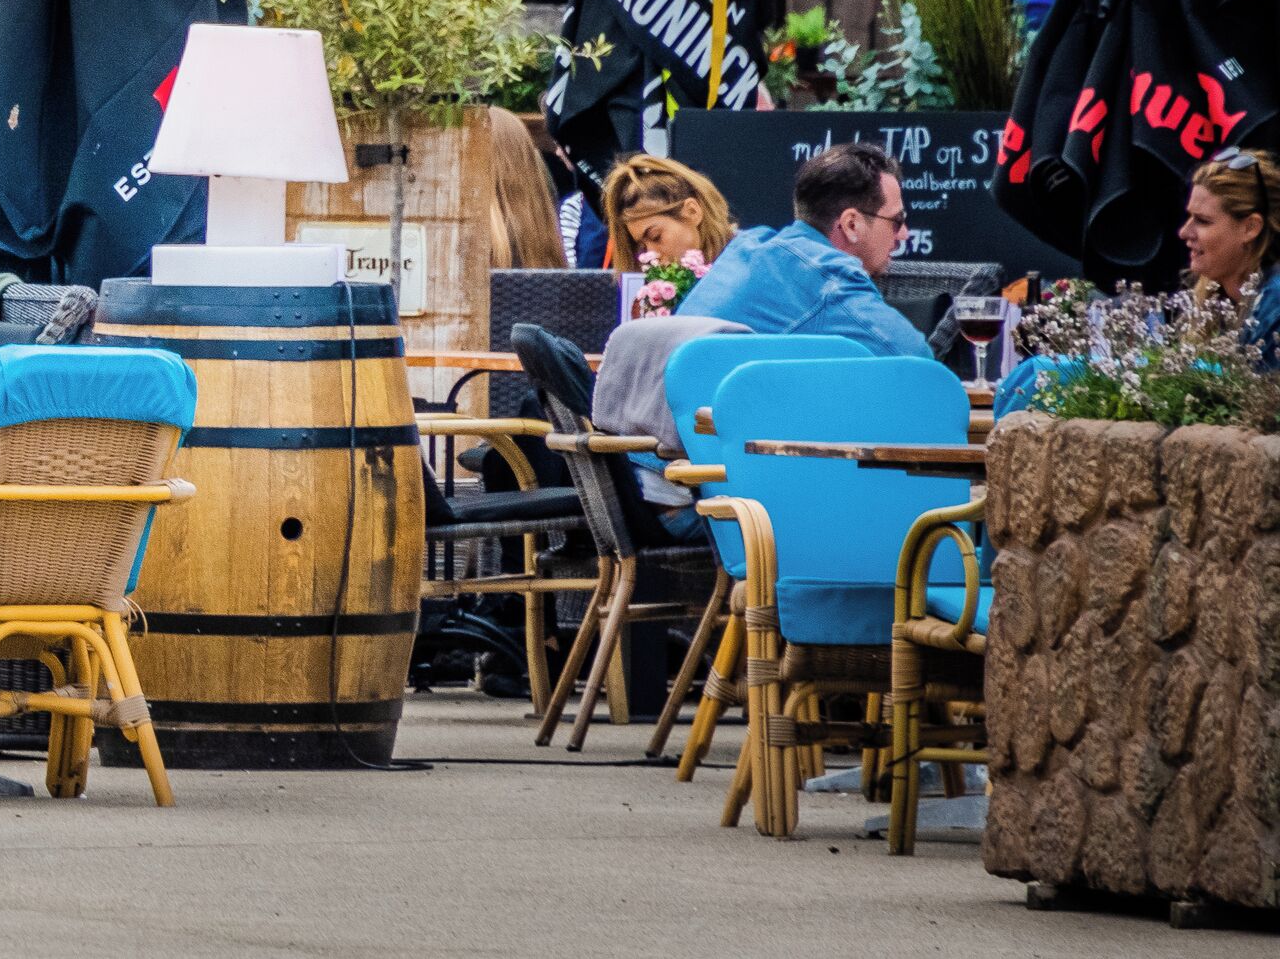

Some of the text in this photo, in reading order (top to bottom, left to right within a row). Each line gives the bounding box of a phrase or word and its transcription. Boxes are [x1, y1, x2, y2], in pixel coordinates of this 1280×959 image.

[113, 147, 154, 202] ES
[878, 126, 931, 165] TAP
[936, 145, 964, 177] op
[345, 246, 413, 278] Trape
